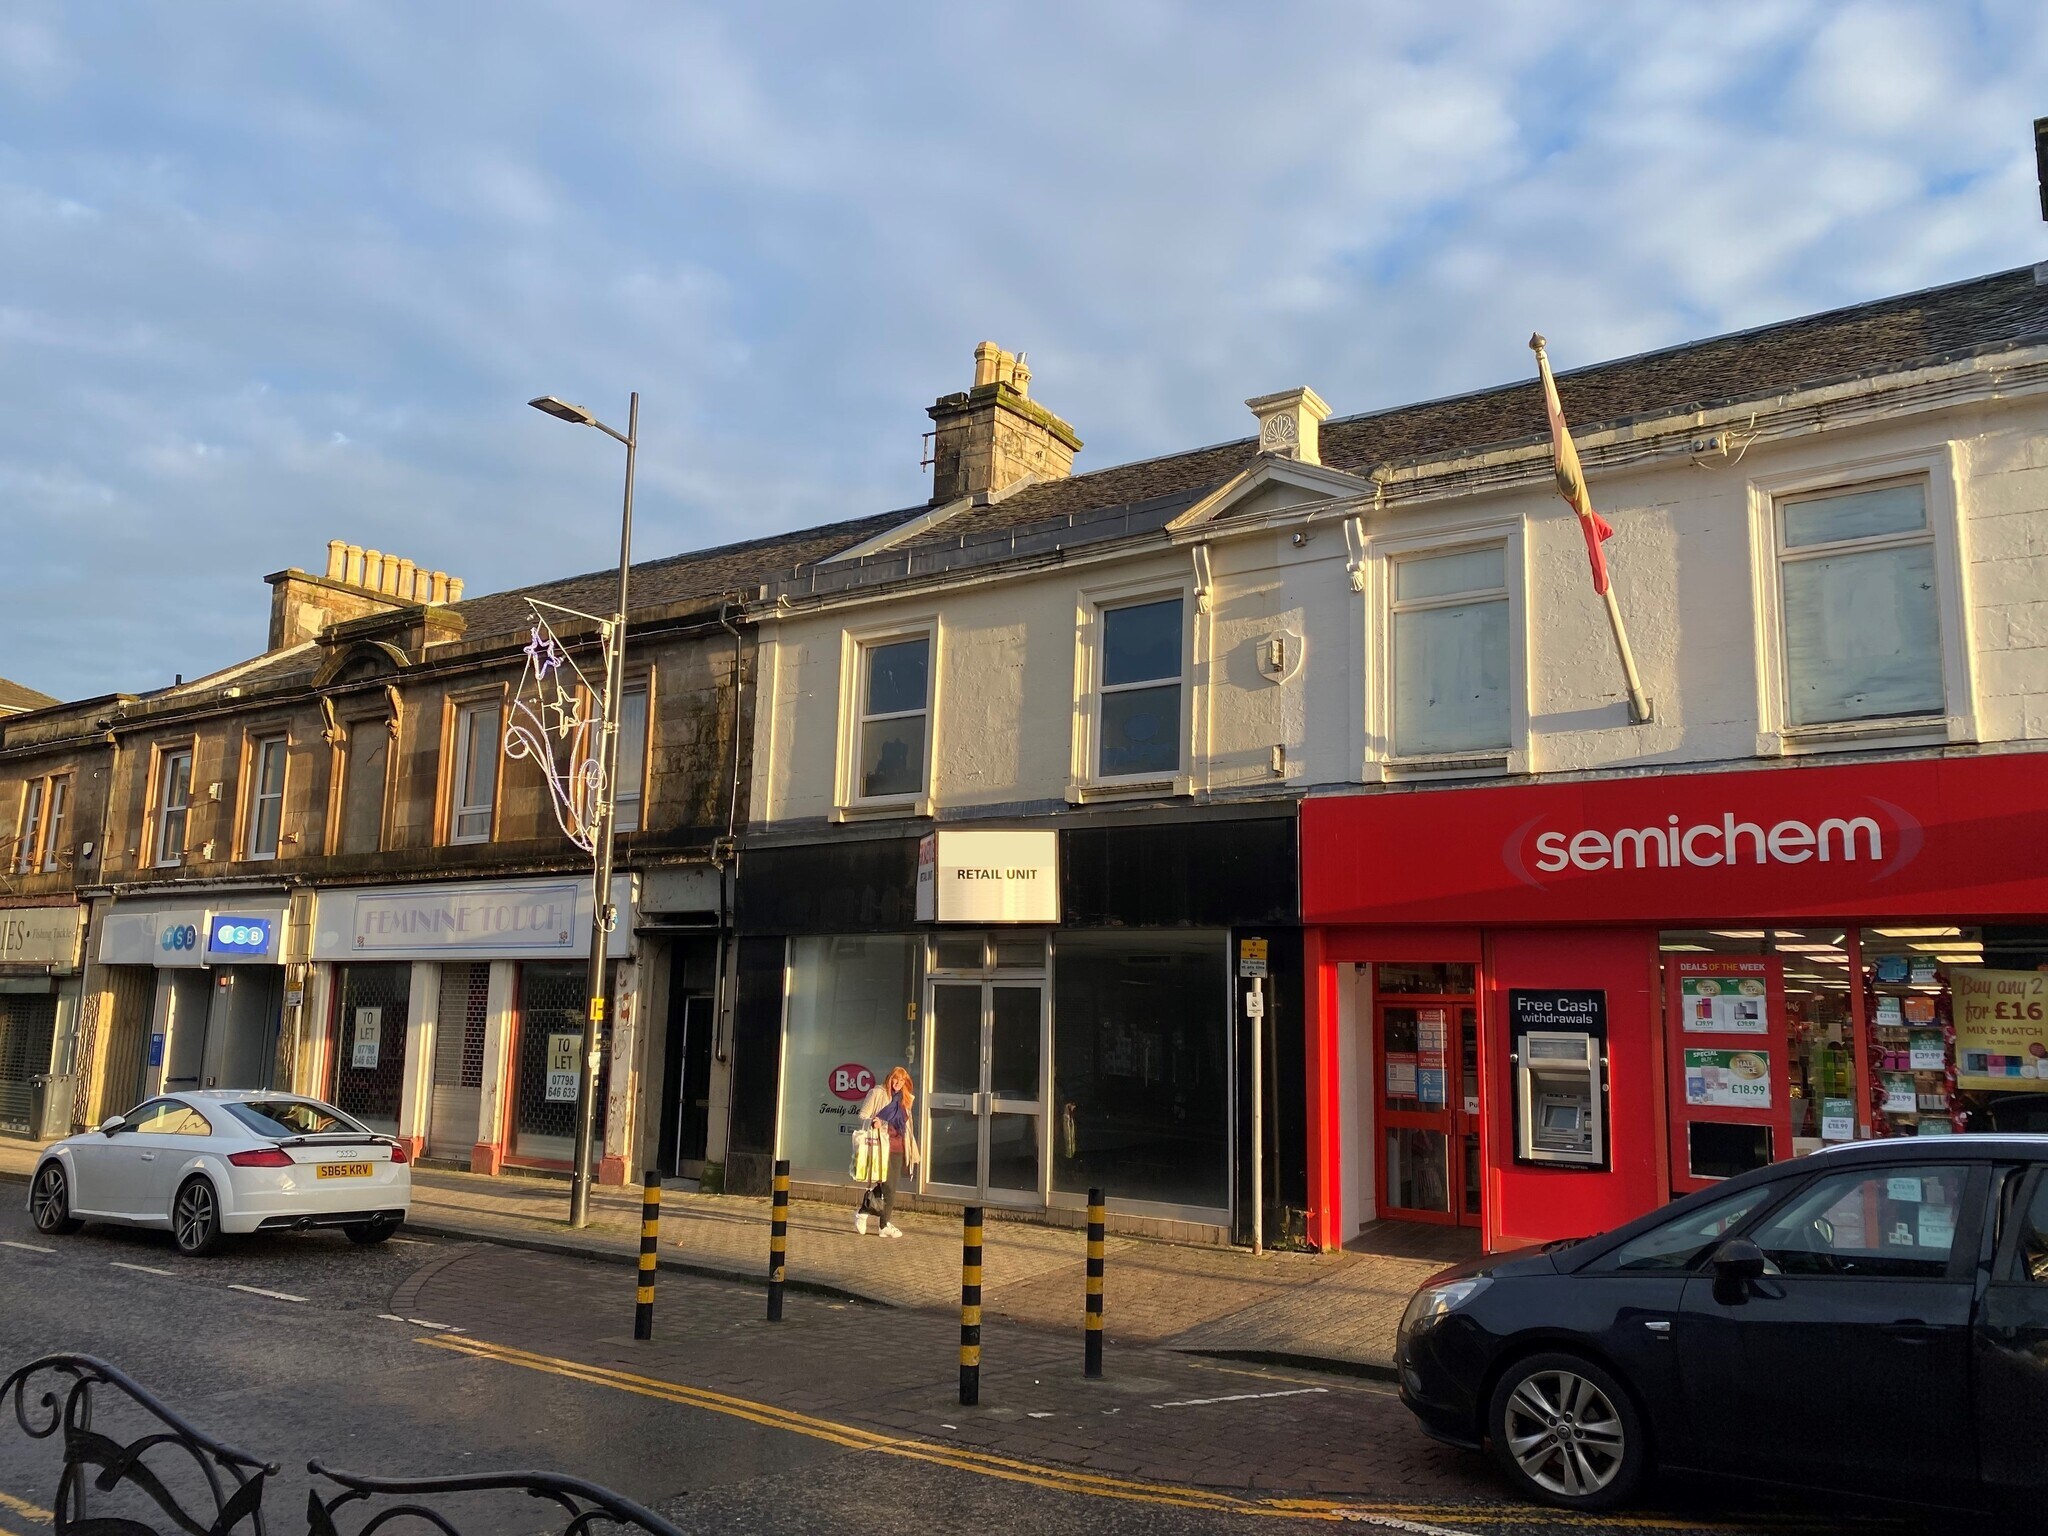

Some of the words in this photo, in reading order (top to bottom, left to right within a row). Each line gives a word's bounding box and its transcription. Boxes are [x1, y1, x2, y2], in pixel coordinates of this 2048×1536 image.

[1535, 812, 1883, 872] semichem
[957, 869, 1002, 880] RETAIL
[1006, 869, 1038, 880] UNIT
[364, 907, 471, 934] FEMININE
[480, 904, 563, 932] TOUCH
[0, 920, 25, 951] IES
[163, 928, 196, 948] TSB
[220, 927, 261, 943] TSB
[1680, 963, 1707, 971] DEALS
[1739, 963, 1766, 971] WEEK
[1961, 976, 1992, 999] Buy
[1997, 981, 2026, 1000] any
[2031, 978, 2043, 995] 2
[1517, 997, 1553, 1011] Free
[1557, 998, 1598, 1012] Cash
[1965, 1000, 1991, 1023] for
[1995, 1001, 2044, 1021] £16
[362, 1011, 373, 1025] TO
[1521, 1012, 1593, 1024] withdrawals
[360, 1028, 375, 1040] LET
[1966, 1026, 1988, 1035] MIX
[1990, 1026, 1998, 1035] &
[2001, 1027, 2043, 1037] MATCH
[558, 1038, 570, 1053] TO
[1692, 1050, 1718, 1058] SPECIAL
[554, 1055, 573, 1070] LET
[551, 1075, 574, 1085] 07798
[835, 1070, 871, 1092] B&C
[548, 1087, 561, 1097] 646
[562, 1088, 576, 1098] 635
[1731, 1084, 1765, 1095] £18.99
[1826, 1100, 1852, 1108] SPECIAL
[1890, 1094, 1912, 1102] 39.99
[819, 1103, 846, 1117] Family
[349, 1164, 369, 1176] KRV
